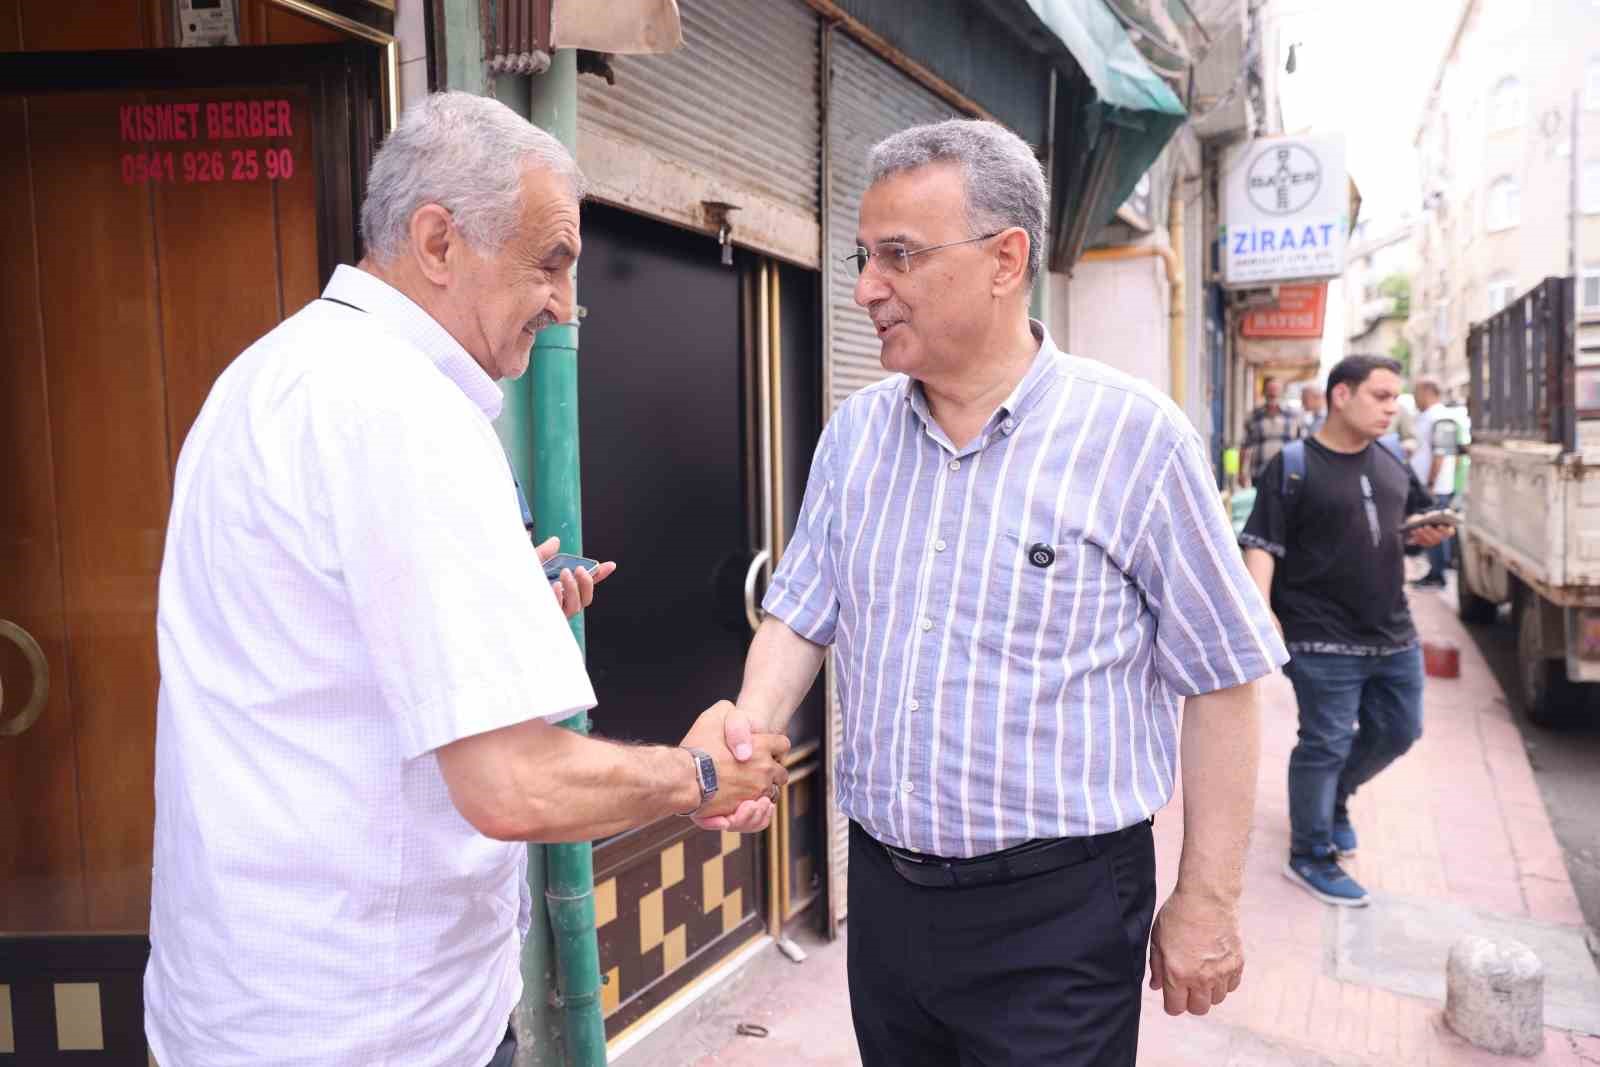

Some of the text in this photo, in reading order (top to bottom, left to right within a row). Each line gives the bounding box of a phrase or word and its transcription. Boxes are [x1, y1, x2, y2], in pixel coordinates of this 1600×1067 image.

[119, 100, 293, 142] KISMET BERBER
[121, 148, 294, 184] 0541 926 25 90
